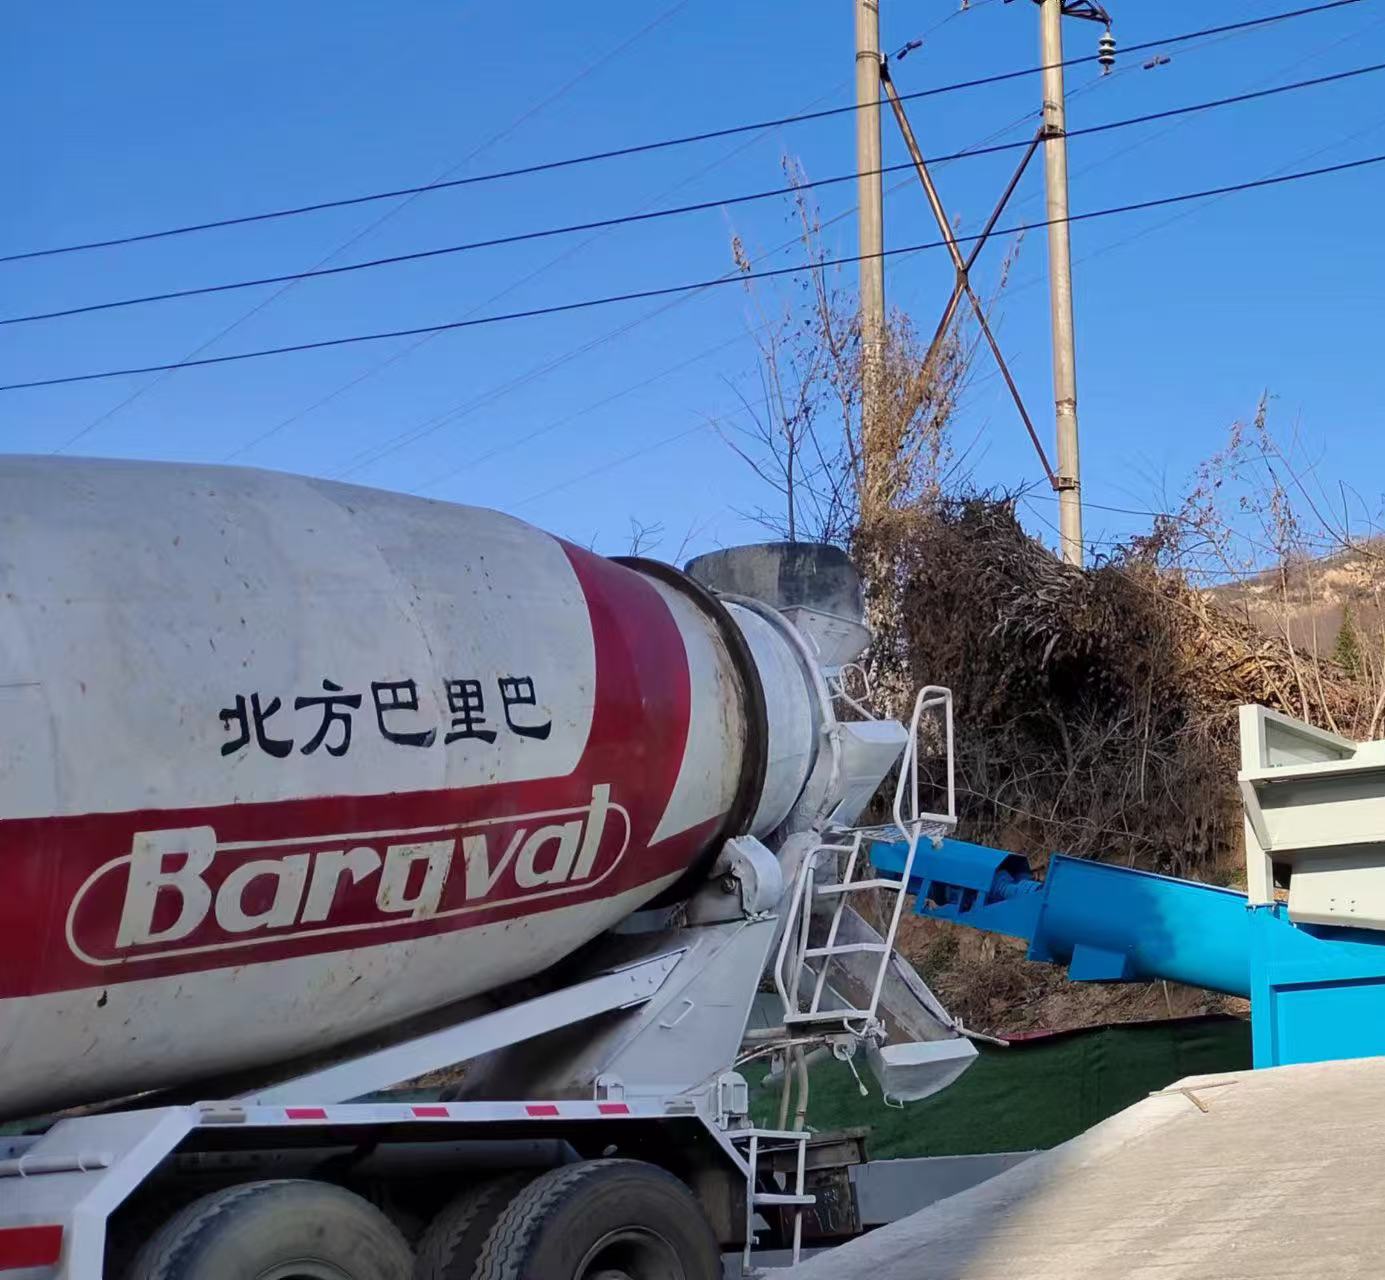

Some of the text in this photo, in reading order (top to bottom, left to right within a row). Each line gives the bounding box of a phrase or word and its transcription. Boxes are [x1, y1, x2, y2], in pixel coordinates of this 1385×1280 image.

[218, 677, 552, 758] 北方巴里巴
